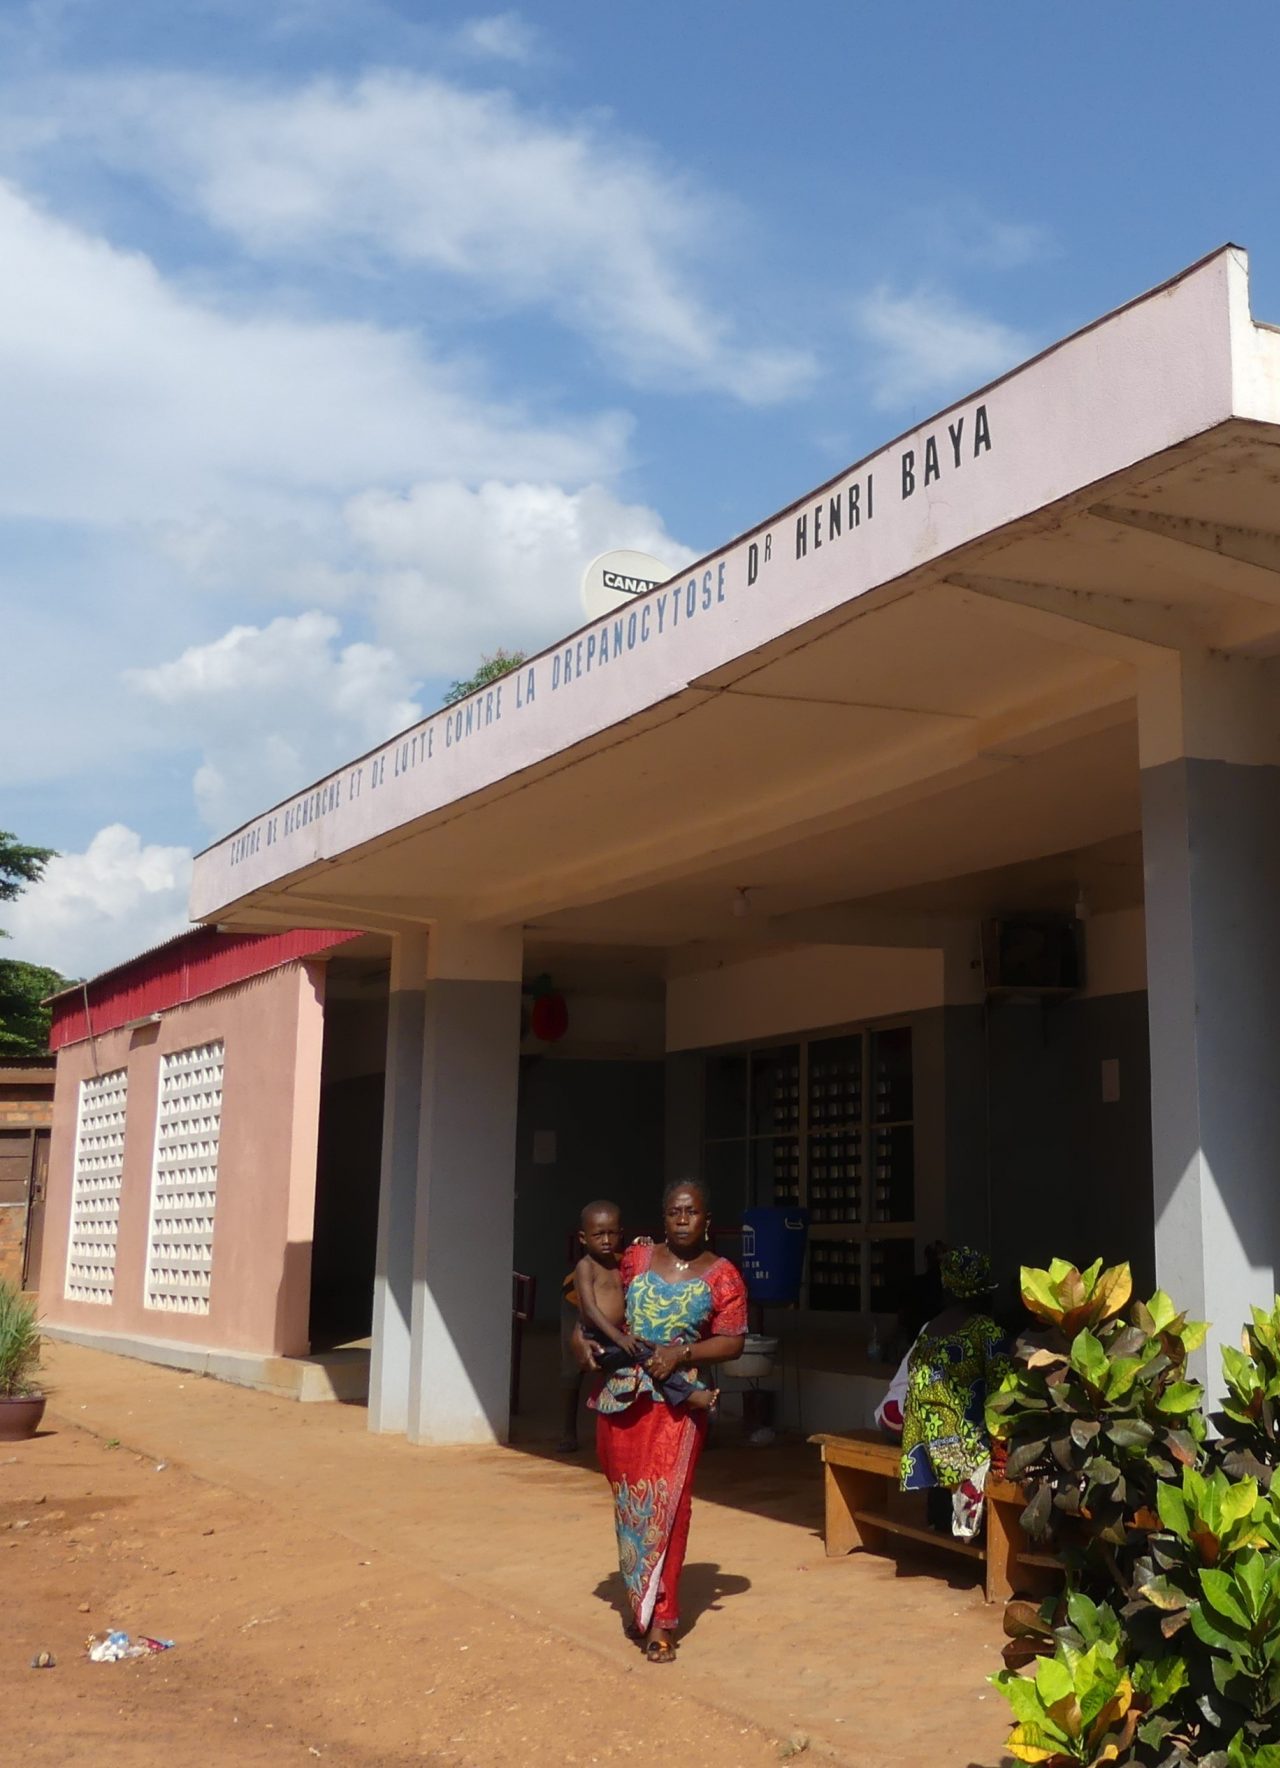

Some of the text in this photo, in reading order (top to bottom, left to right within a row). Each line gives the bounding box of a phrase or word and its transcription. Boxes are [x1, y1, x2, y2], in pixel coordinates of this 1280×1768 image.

[231, 826, 261, 867] CENTRE
[267, 816, 278, 847] DE
[284, 780, 341, 837] RECHERCHE
[349, 768, 363, 801] ET
[371, 755, 385, 789] DE
[395, 726, 434, 777] LUTTE
[446, 685, 503, 748] CONTRE
[516, 667, 536, 710] LA
[552, 561, 726, 691] DREPANOCYTOSE
[796, 473, 873, 560] HENRI
[902, 404, 992, 501] BAYA
